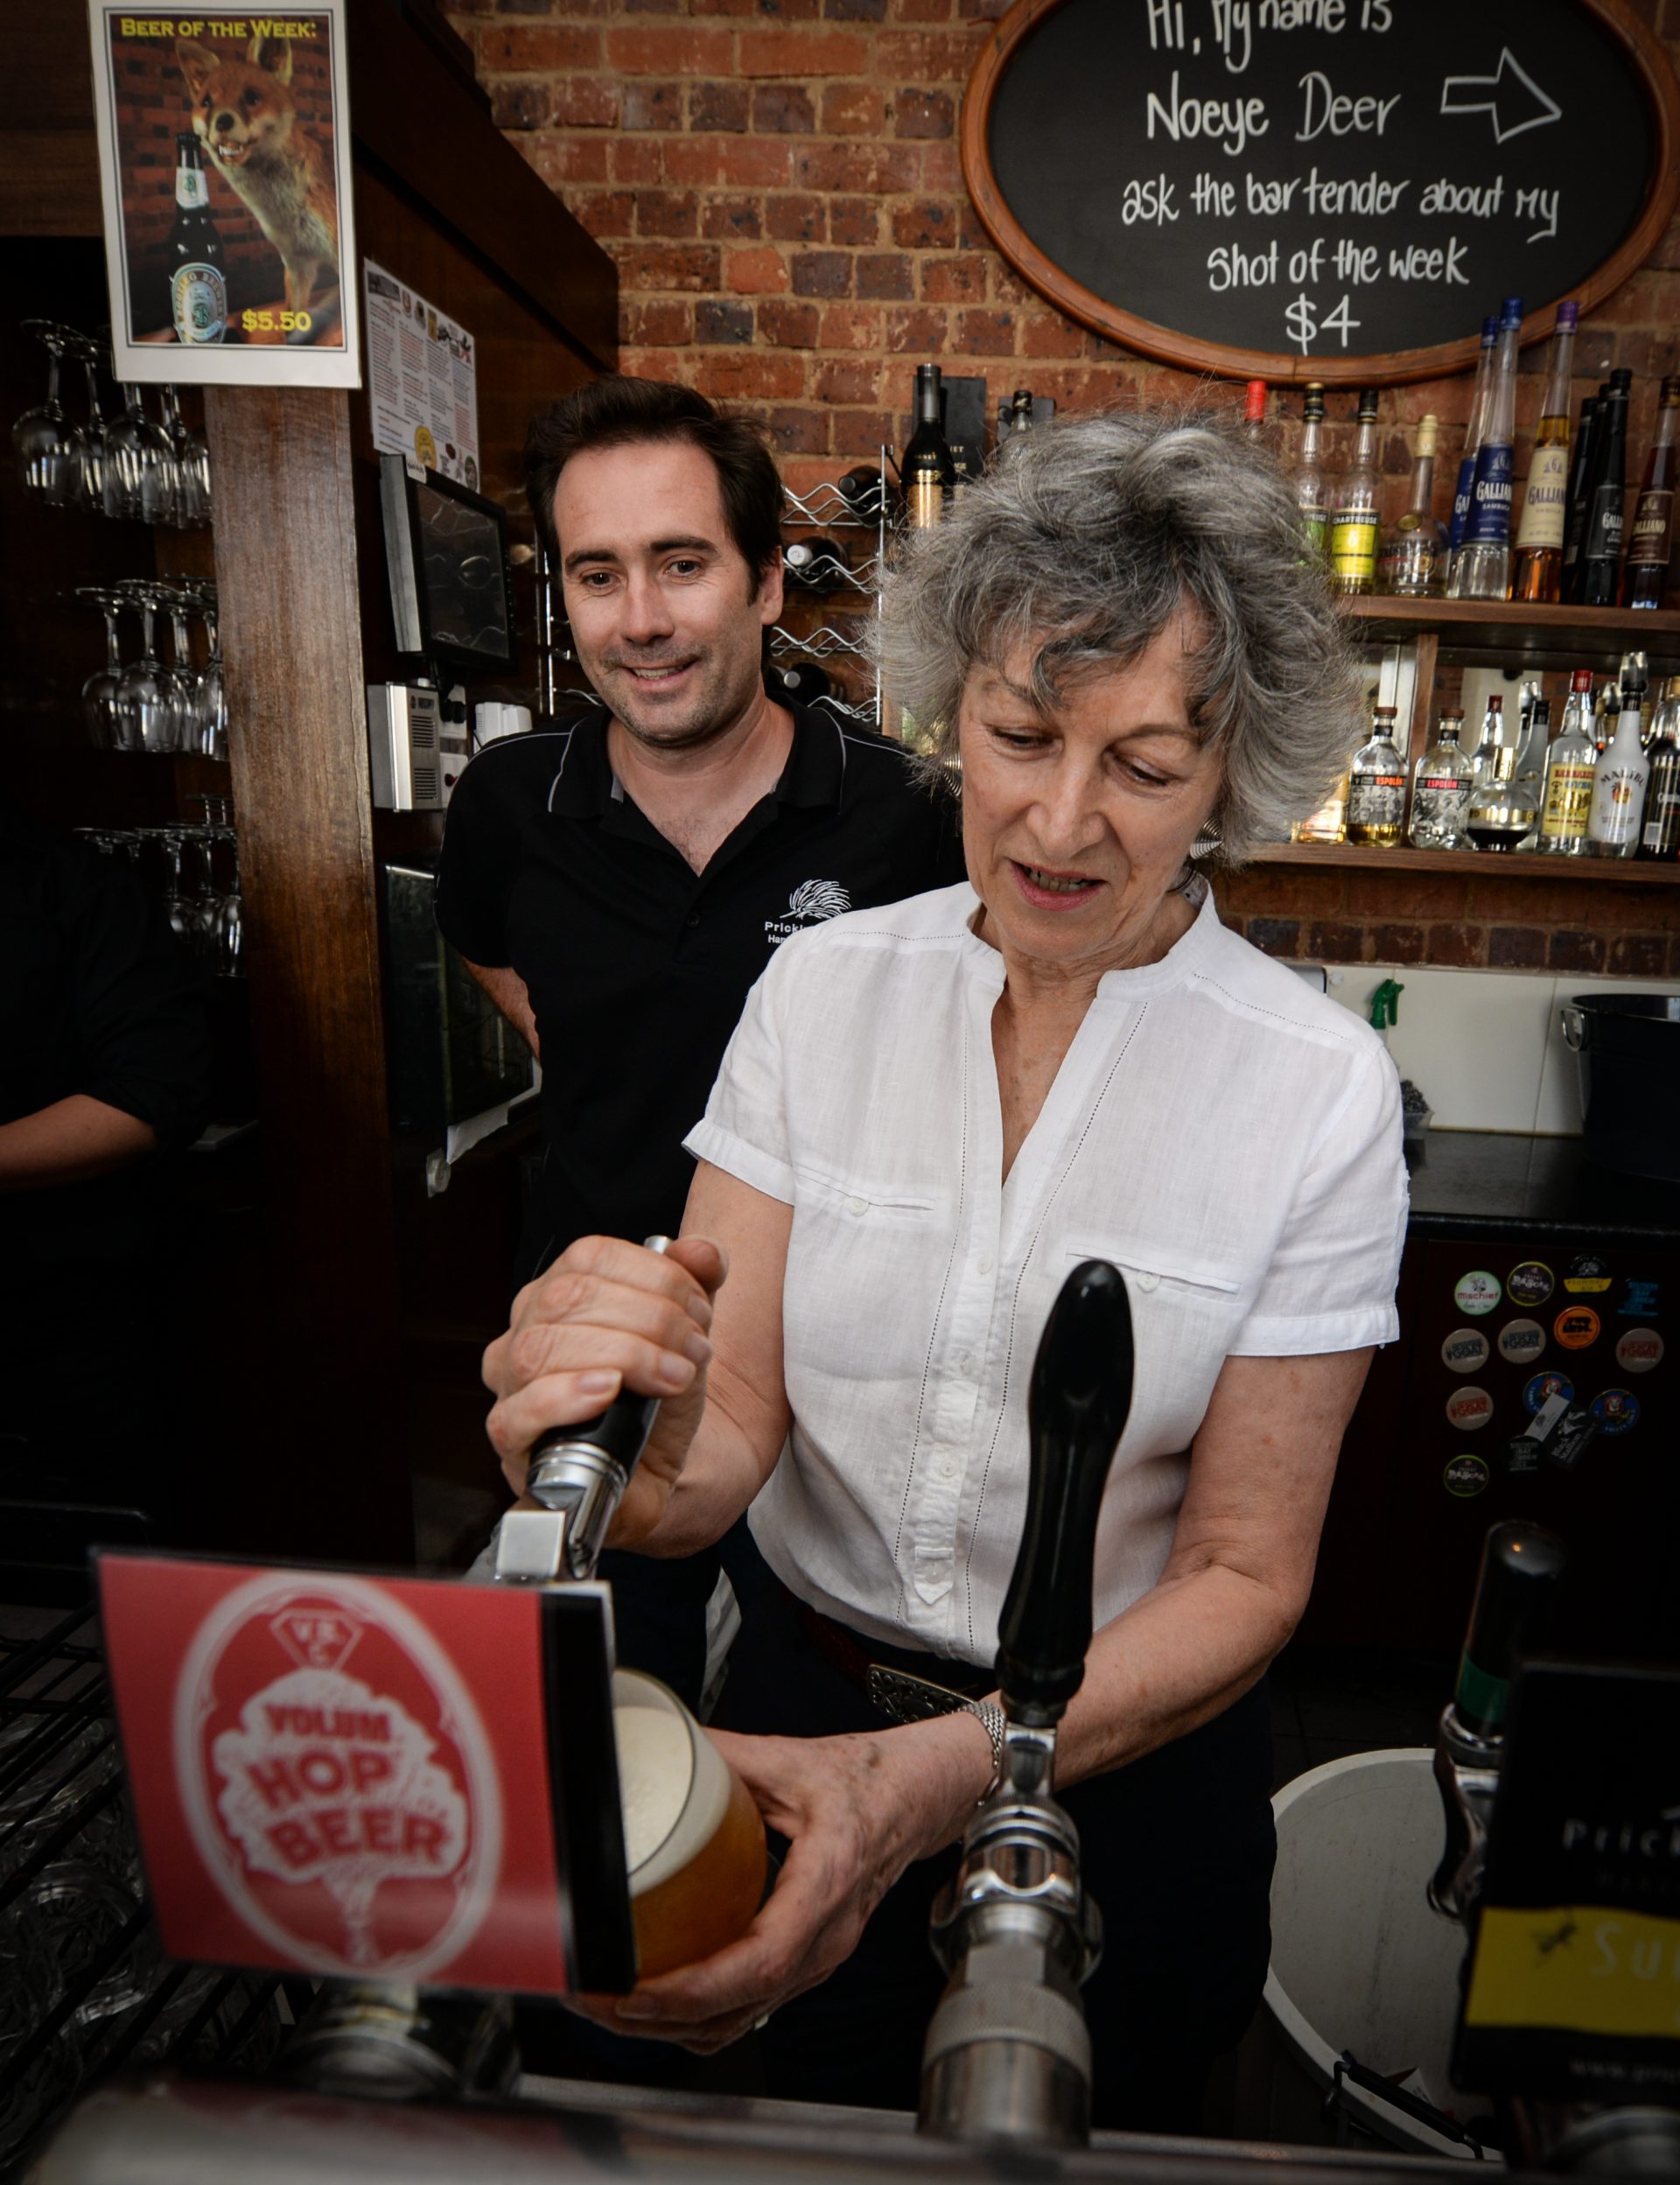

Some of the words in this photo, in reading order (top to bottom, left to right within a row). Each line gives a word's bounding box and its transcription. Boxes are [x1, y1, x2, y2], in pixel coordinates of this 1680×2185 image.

[120, 18, 175, 37] BEER
[178, 21, 205, 37] OF
[208, 21, 248, 38] THE
[249, 18, 318, 39] WEEK:
[1146, 70, 1270, 157] Noeye
[1294, 71, 1402, 142] Deer
[1122, 172, 1180, 227] ask
[1189, 172, 1236, 217] the
[1418, 175, 1504, 219] about
[1288, 237, 1326, 284] of
[1331, 238, 1382, 286] the
[1389, 235, 1470, 286] week
[242, 308, 312, 333] $5.50
[1284, 292, 1362, 357] $4
[1332, 514, 1378, 525] CHARTREUSE
[246, 1747, 392, 1810] HOP
[265, 1805, 452, 1871] BEER
